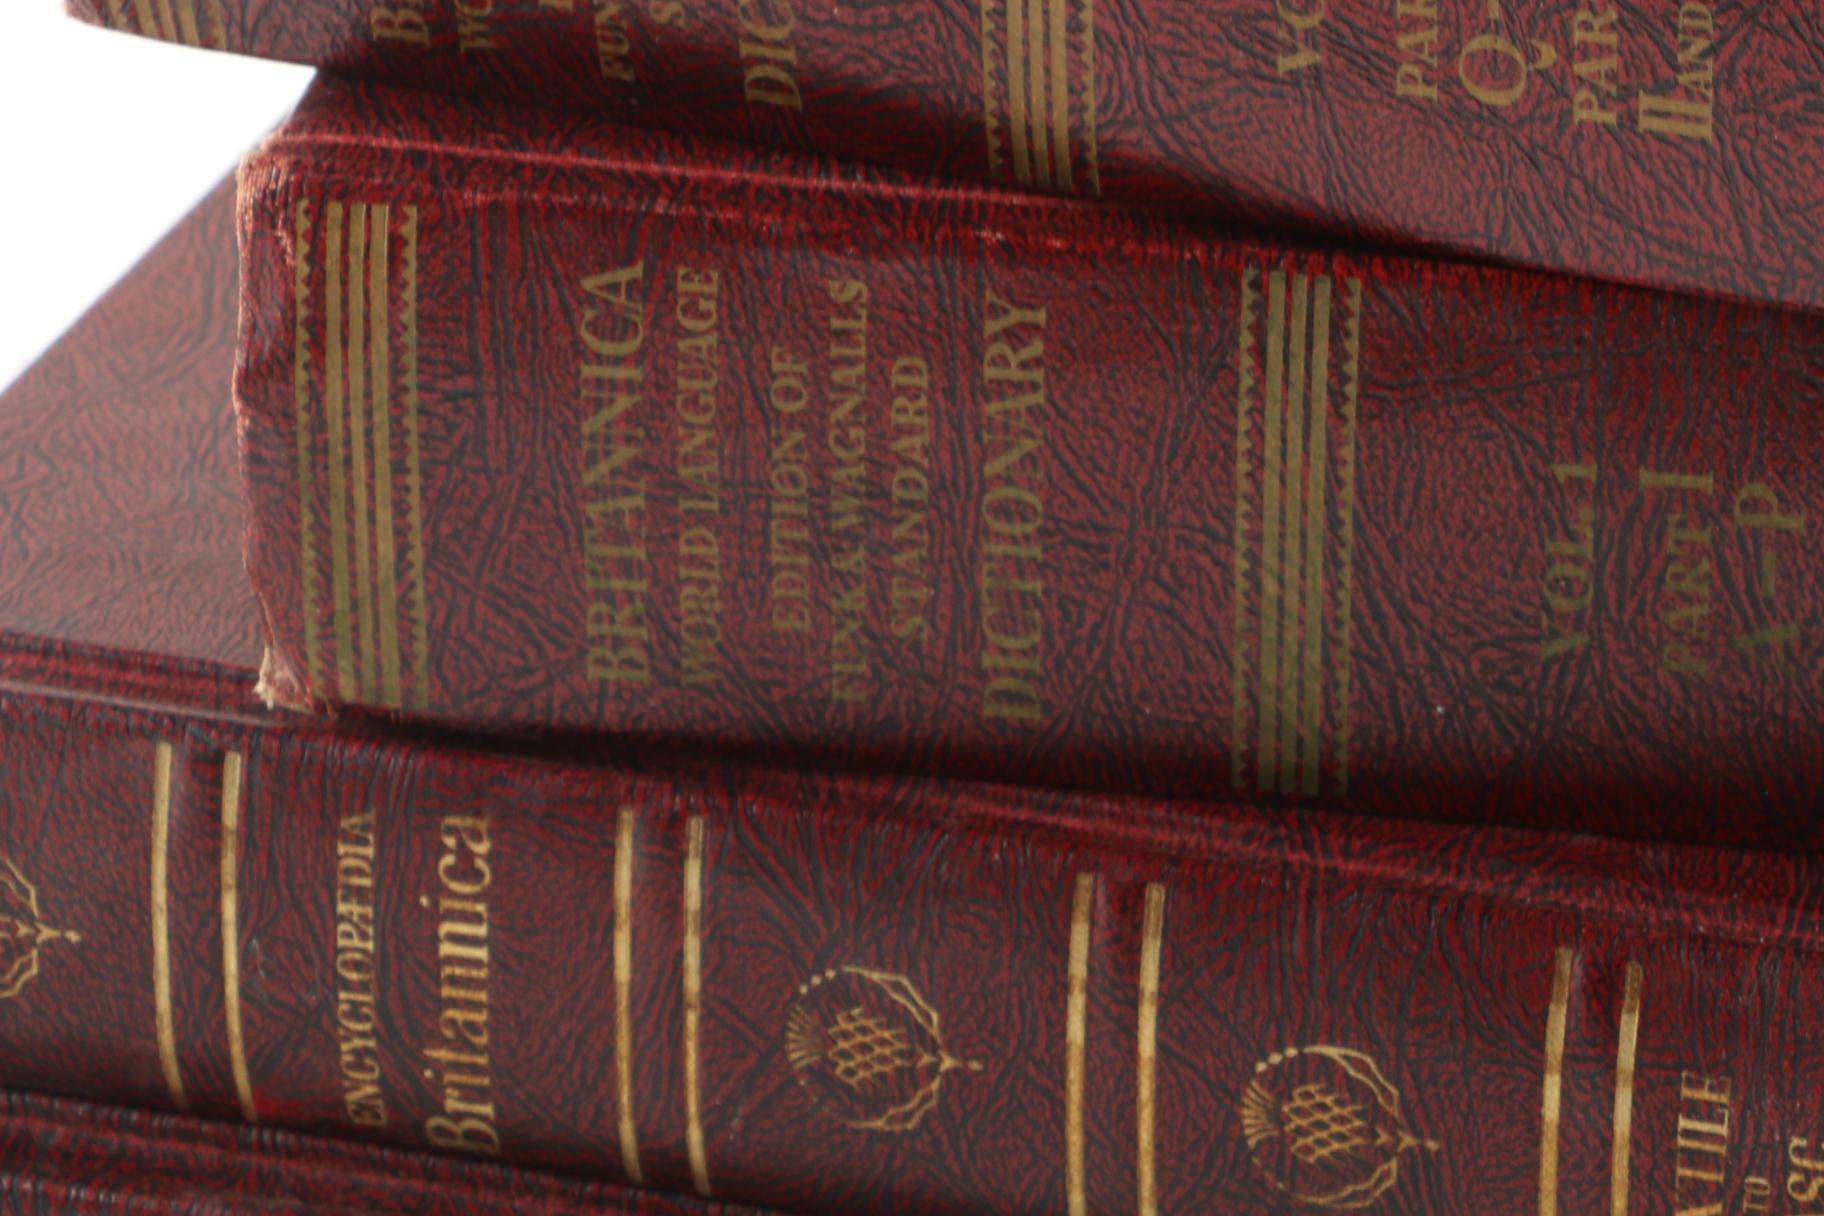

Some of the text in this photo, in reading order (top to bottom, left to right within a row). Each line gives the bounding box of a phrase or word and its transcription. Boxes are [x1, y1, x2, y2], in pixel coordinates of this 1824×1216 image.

[1678, 2, 1714, 99] AND
[580, 259, 650, 685] BRITANNICA
[677, 267, 721, 688] WORLD LANGUAGE
[770, 346, 810, 633] EDITION OF
[828, 278, 869, 706] FUNK & WAGNALLS
[890, 355, 930, 643] STANDARD
[981, 289, 1048, 724] DICTIONARY
[1540, 506, 1596, 660] VOL.
[1639, 465, 1715, 674] PART I
[336, 809, 388, 1128] ENCYCLOPÆDIA
[420, 814, 500, 1155] Britannica
